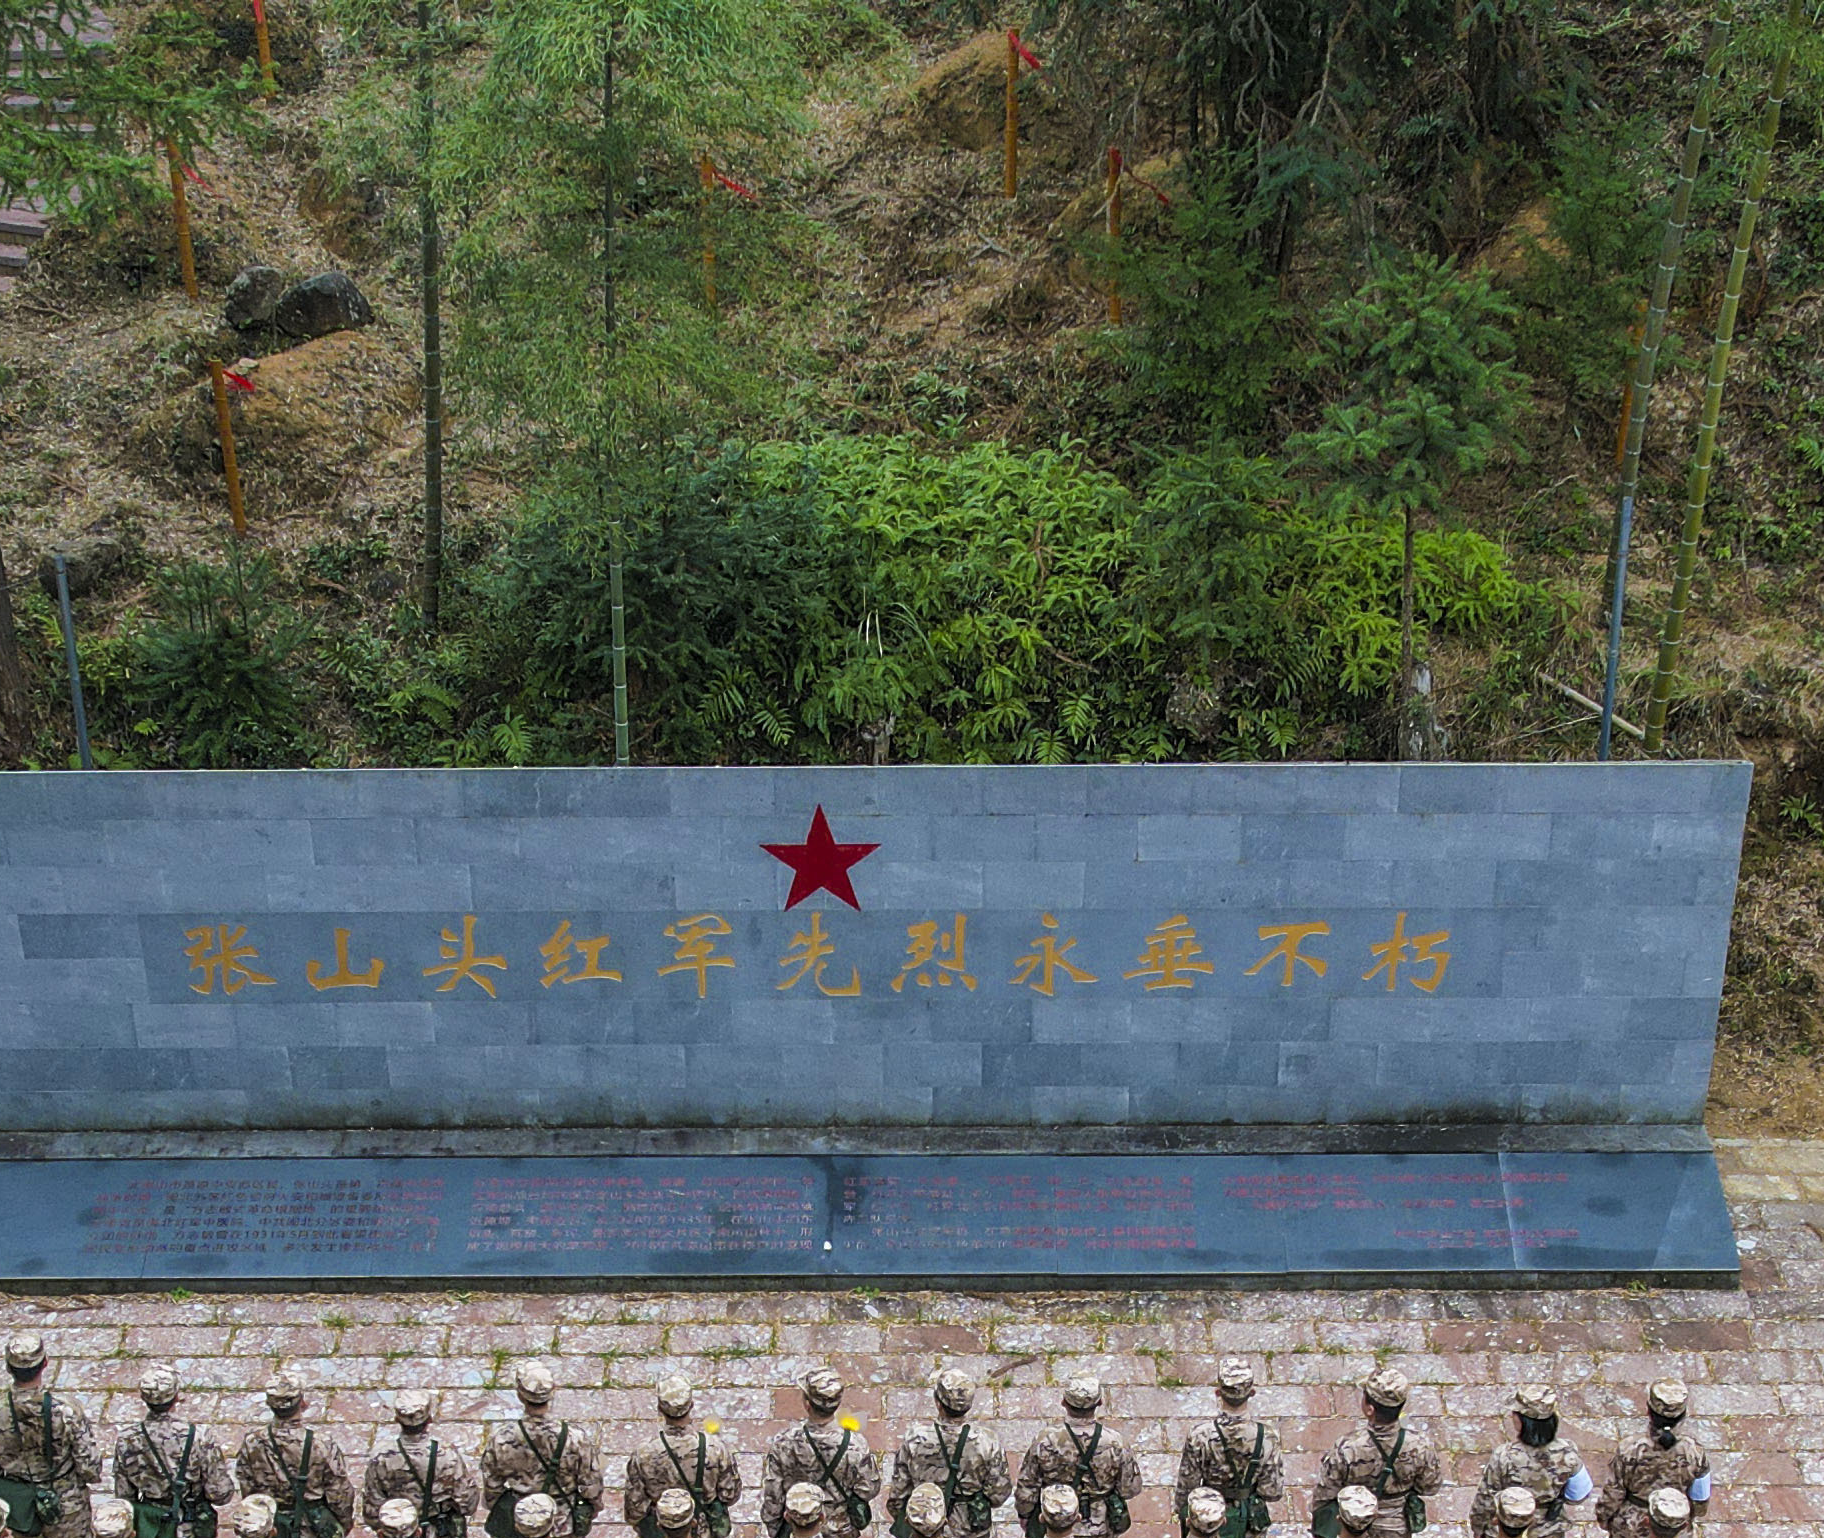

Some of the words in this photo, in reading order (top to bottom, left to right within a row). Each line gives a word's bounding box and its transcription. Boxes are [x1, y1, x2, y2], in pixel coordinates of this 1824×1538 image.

[183, 912, 1451, 999] 张山头红军先烈永垂不朽
